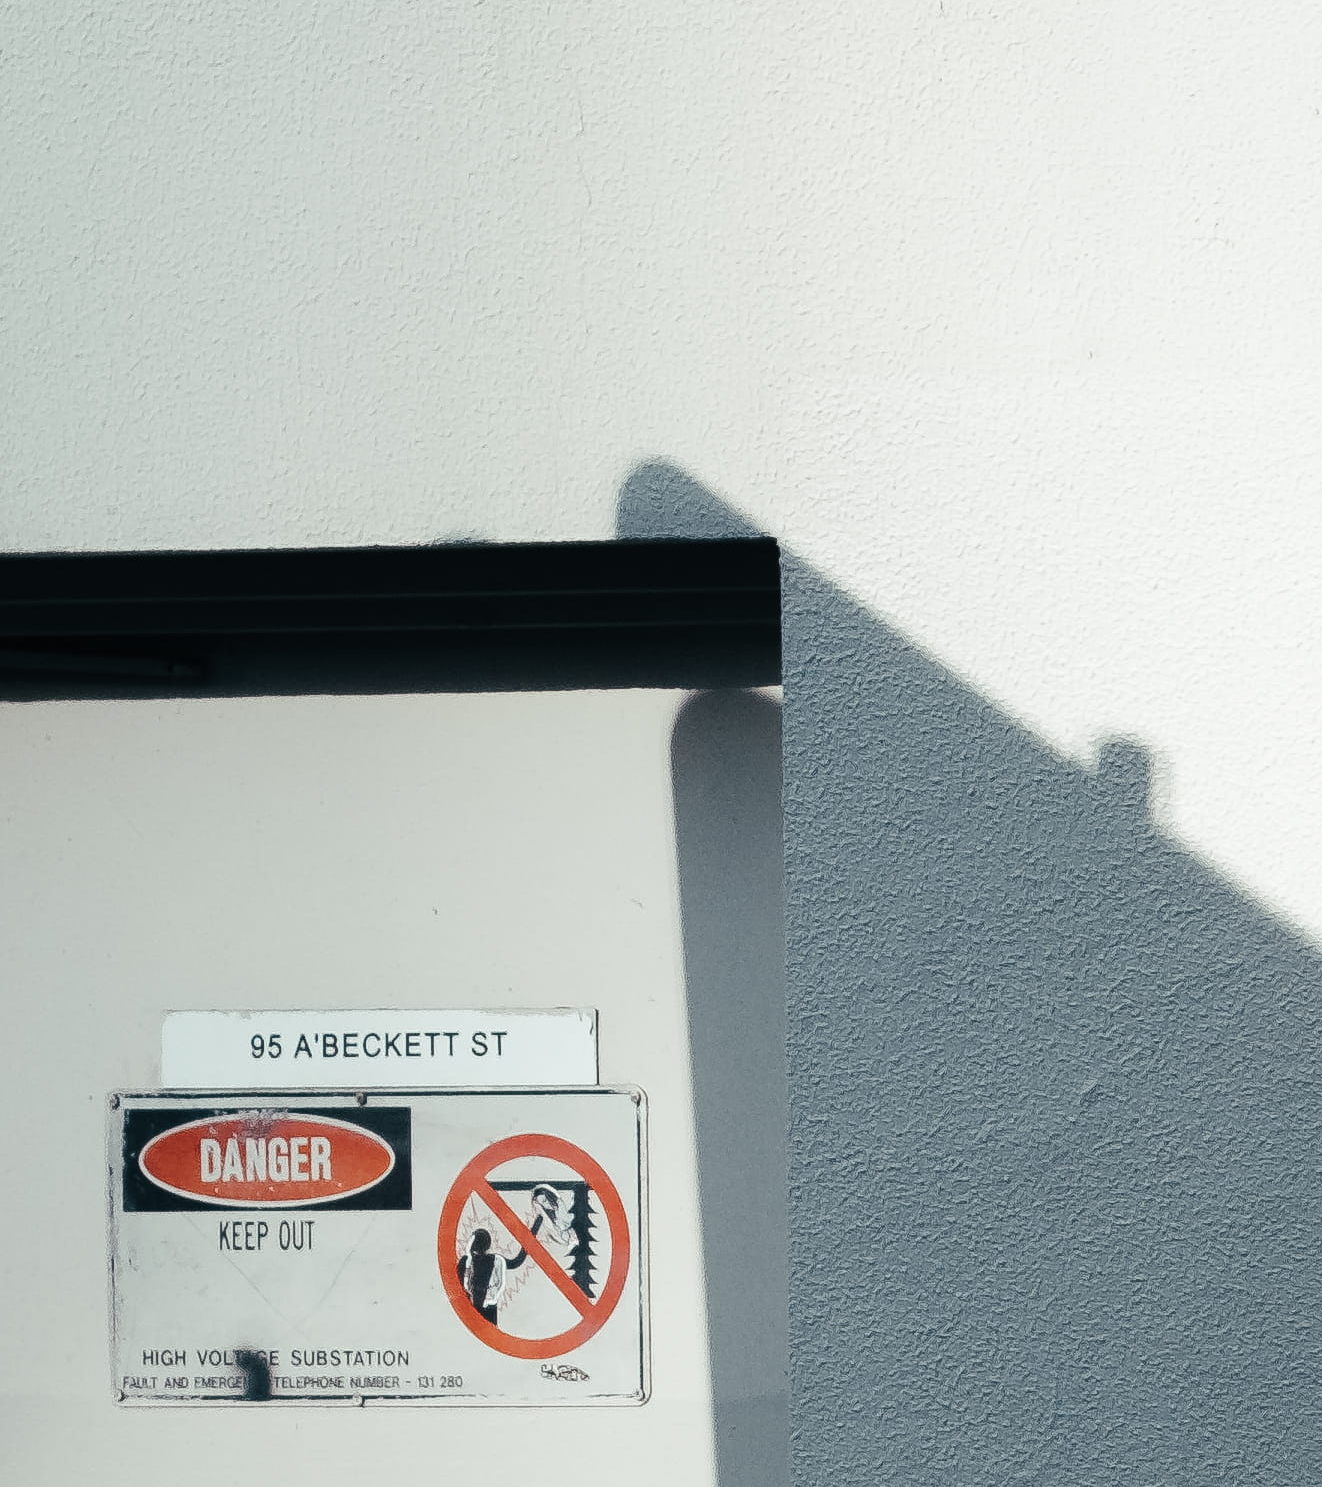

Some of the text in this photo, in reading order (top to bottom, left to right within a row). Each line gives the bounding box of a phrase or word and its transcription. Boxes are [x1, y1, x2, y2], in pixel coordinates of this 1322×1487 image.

[250, 1030, 508, 1059] 95 A'BECKETT ST
[199, 1135, 333, 1183] DANGER
[218, 1220, 316, 1251] KEEP OUT
[142, 1349, 187, 1366] HIGH
[290, 1348, 410, 1367] SUBSTATION
[123, 1376, 158, 1389] FAULT
[164, 1376, 189, 1389] AND
[273, 1376, 345, 1389] TELEPHONE
[350, 1376, 400, 1389] NUMBER
